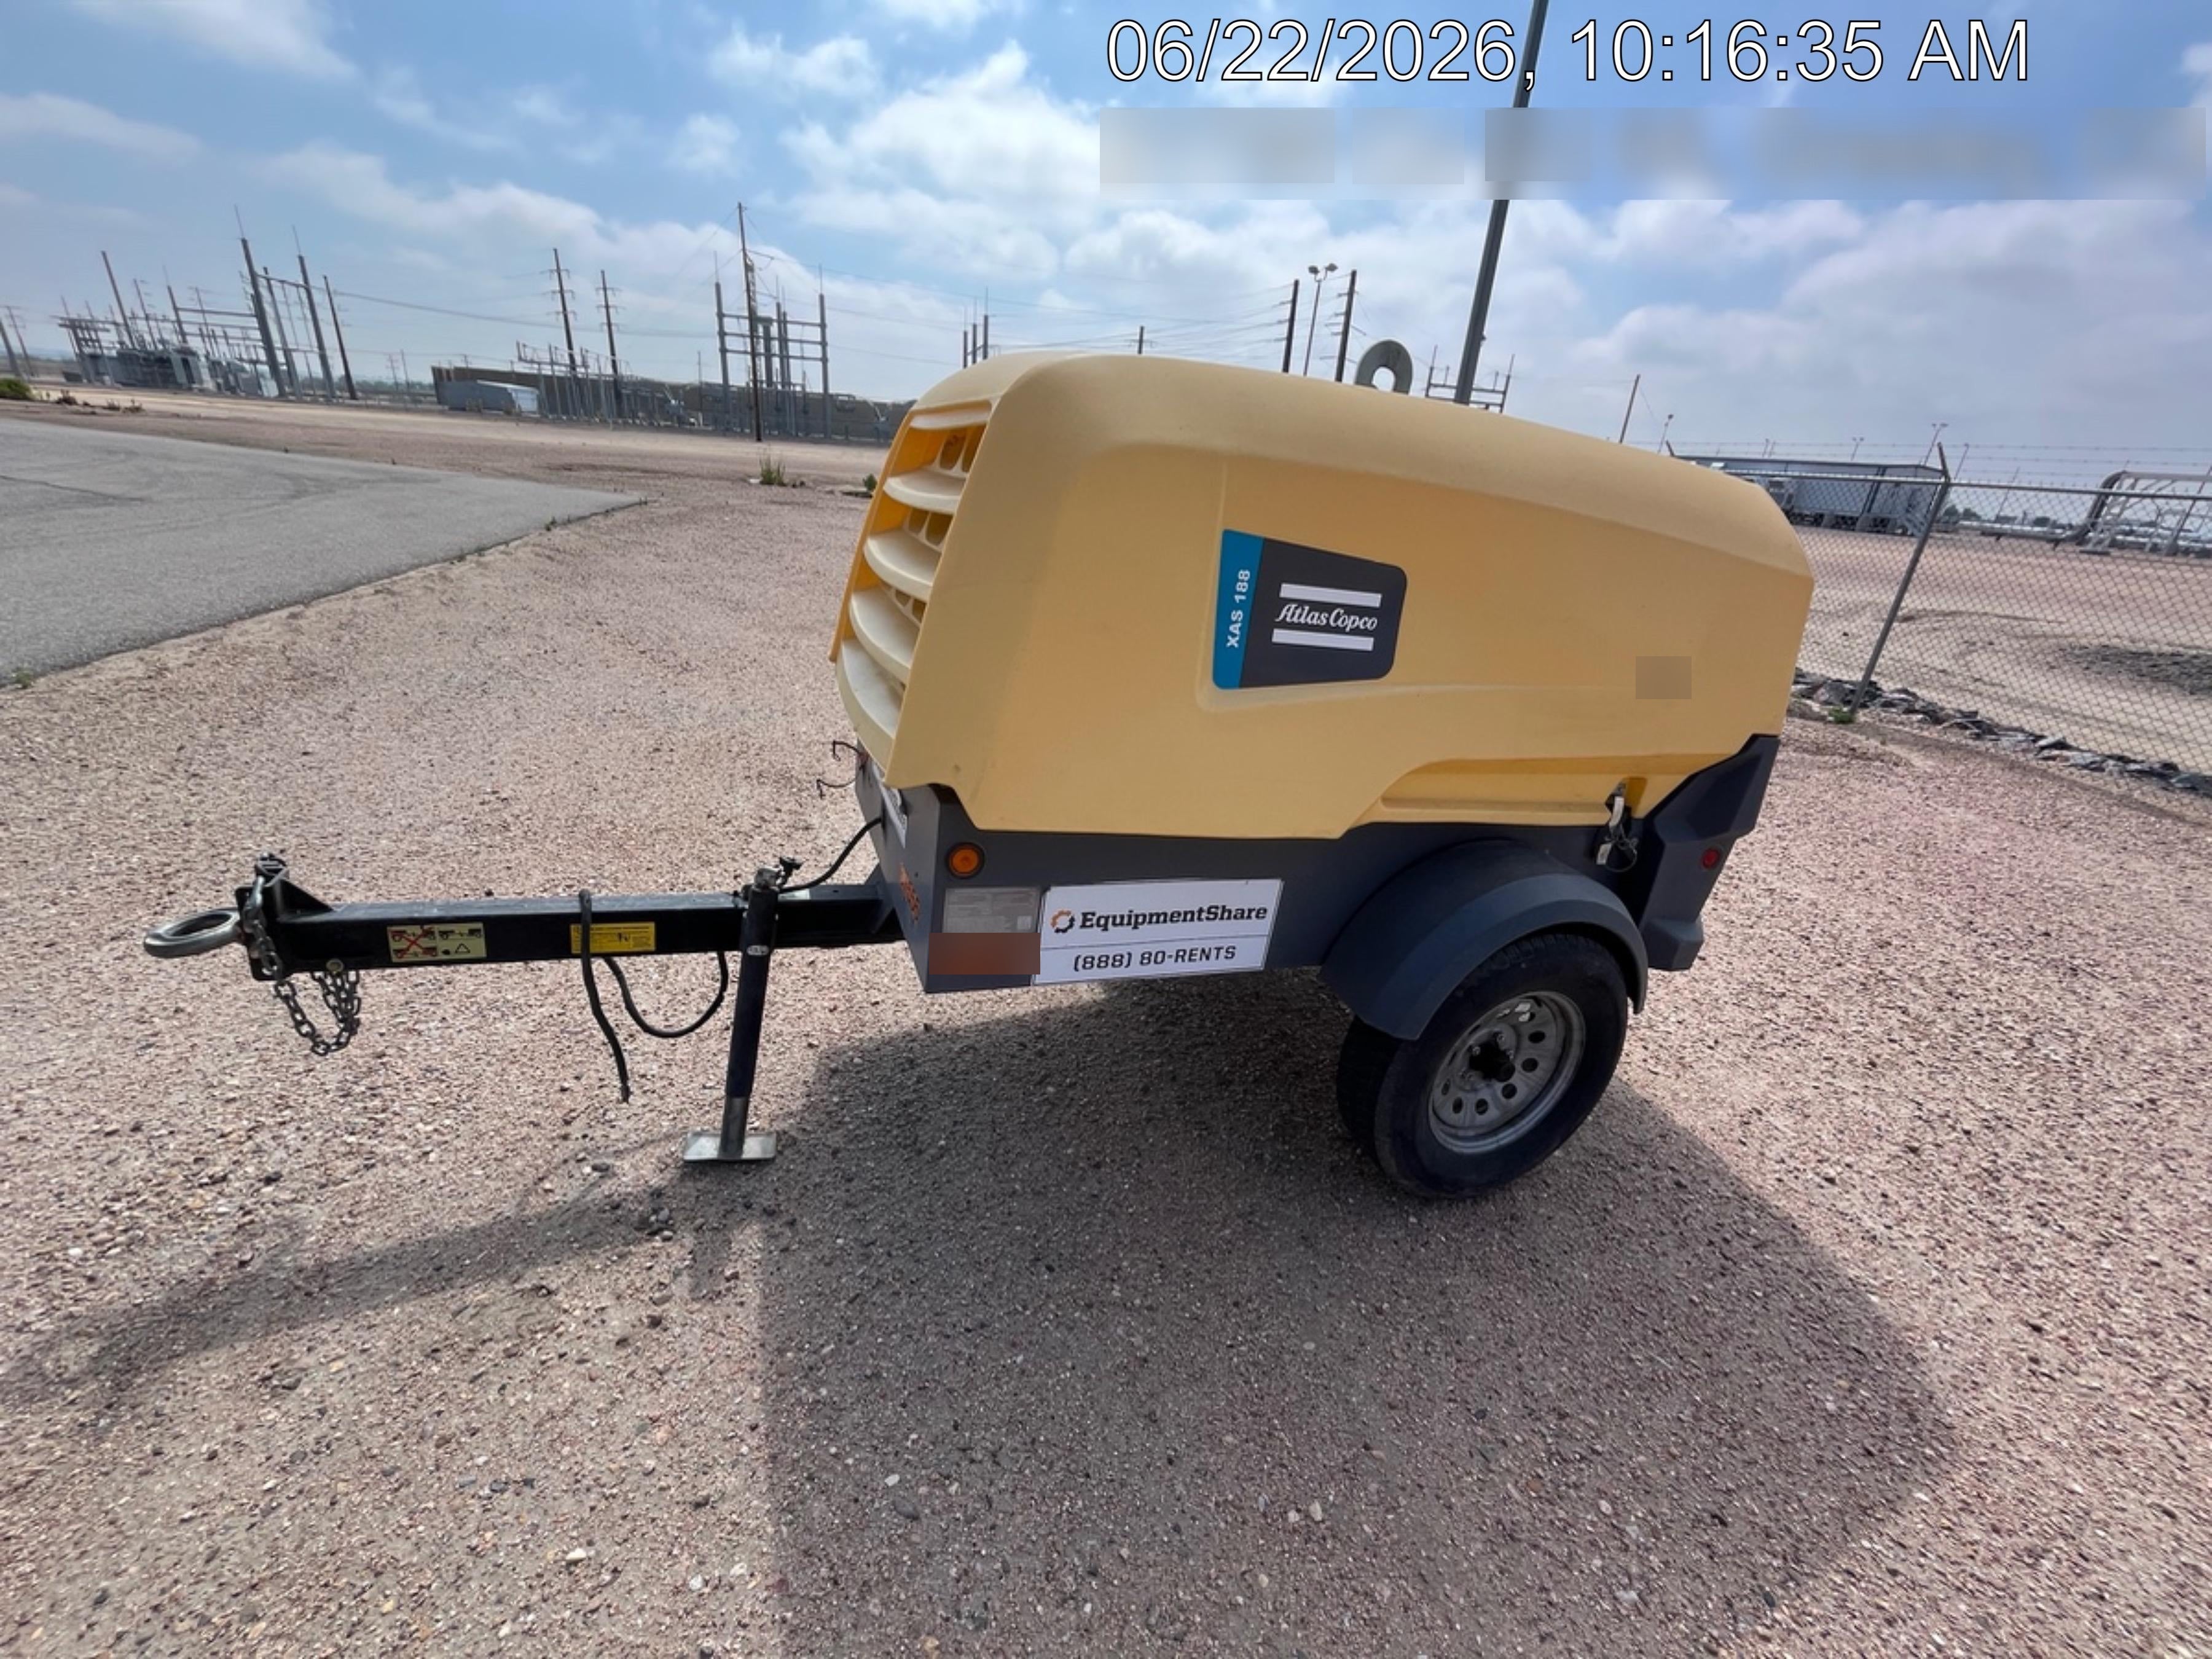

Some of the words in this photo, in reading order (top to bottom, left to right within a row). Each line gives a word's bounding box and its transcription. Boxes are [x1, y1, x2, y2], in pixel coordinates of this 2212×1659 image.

[1234, 570, 1250, 603] 188
[1226, 610, 1244, 648] XAS
[1080, 905, 1268, 931] EquipmentShare
[1073, 954, 1132, 972] (888)
[1139, 946, 1236, 967] 80-RENTS
